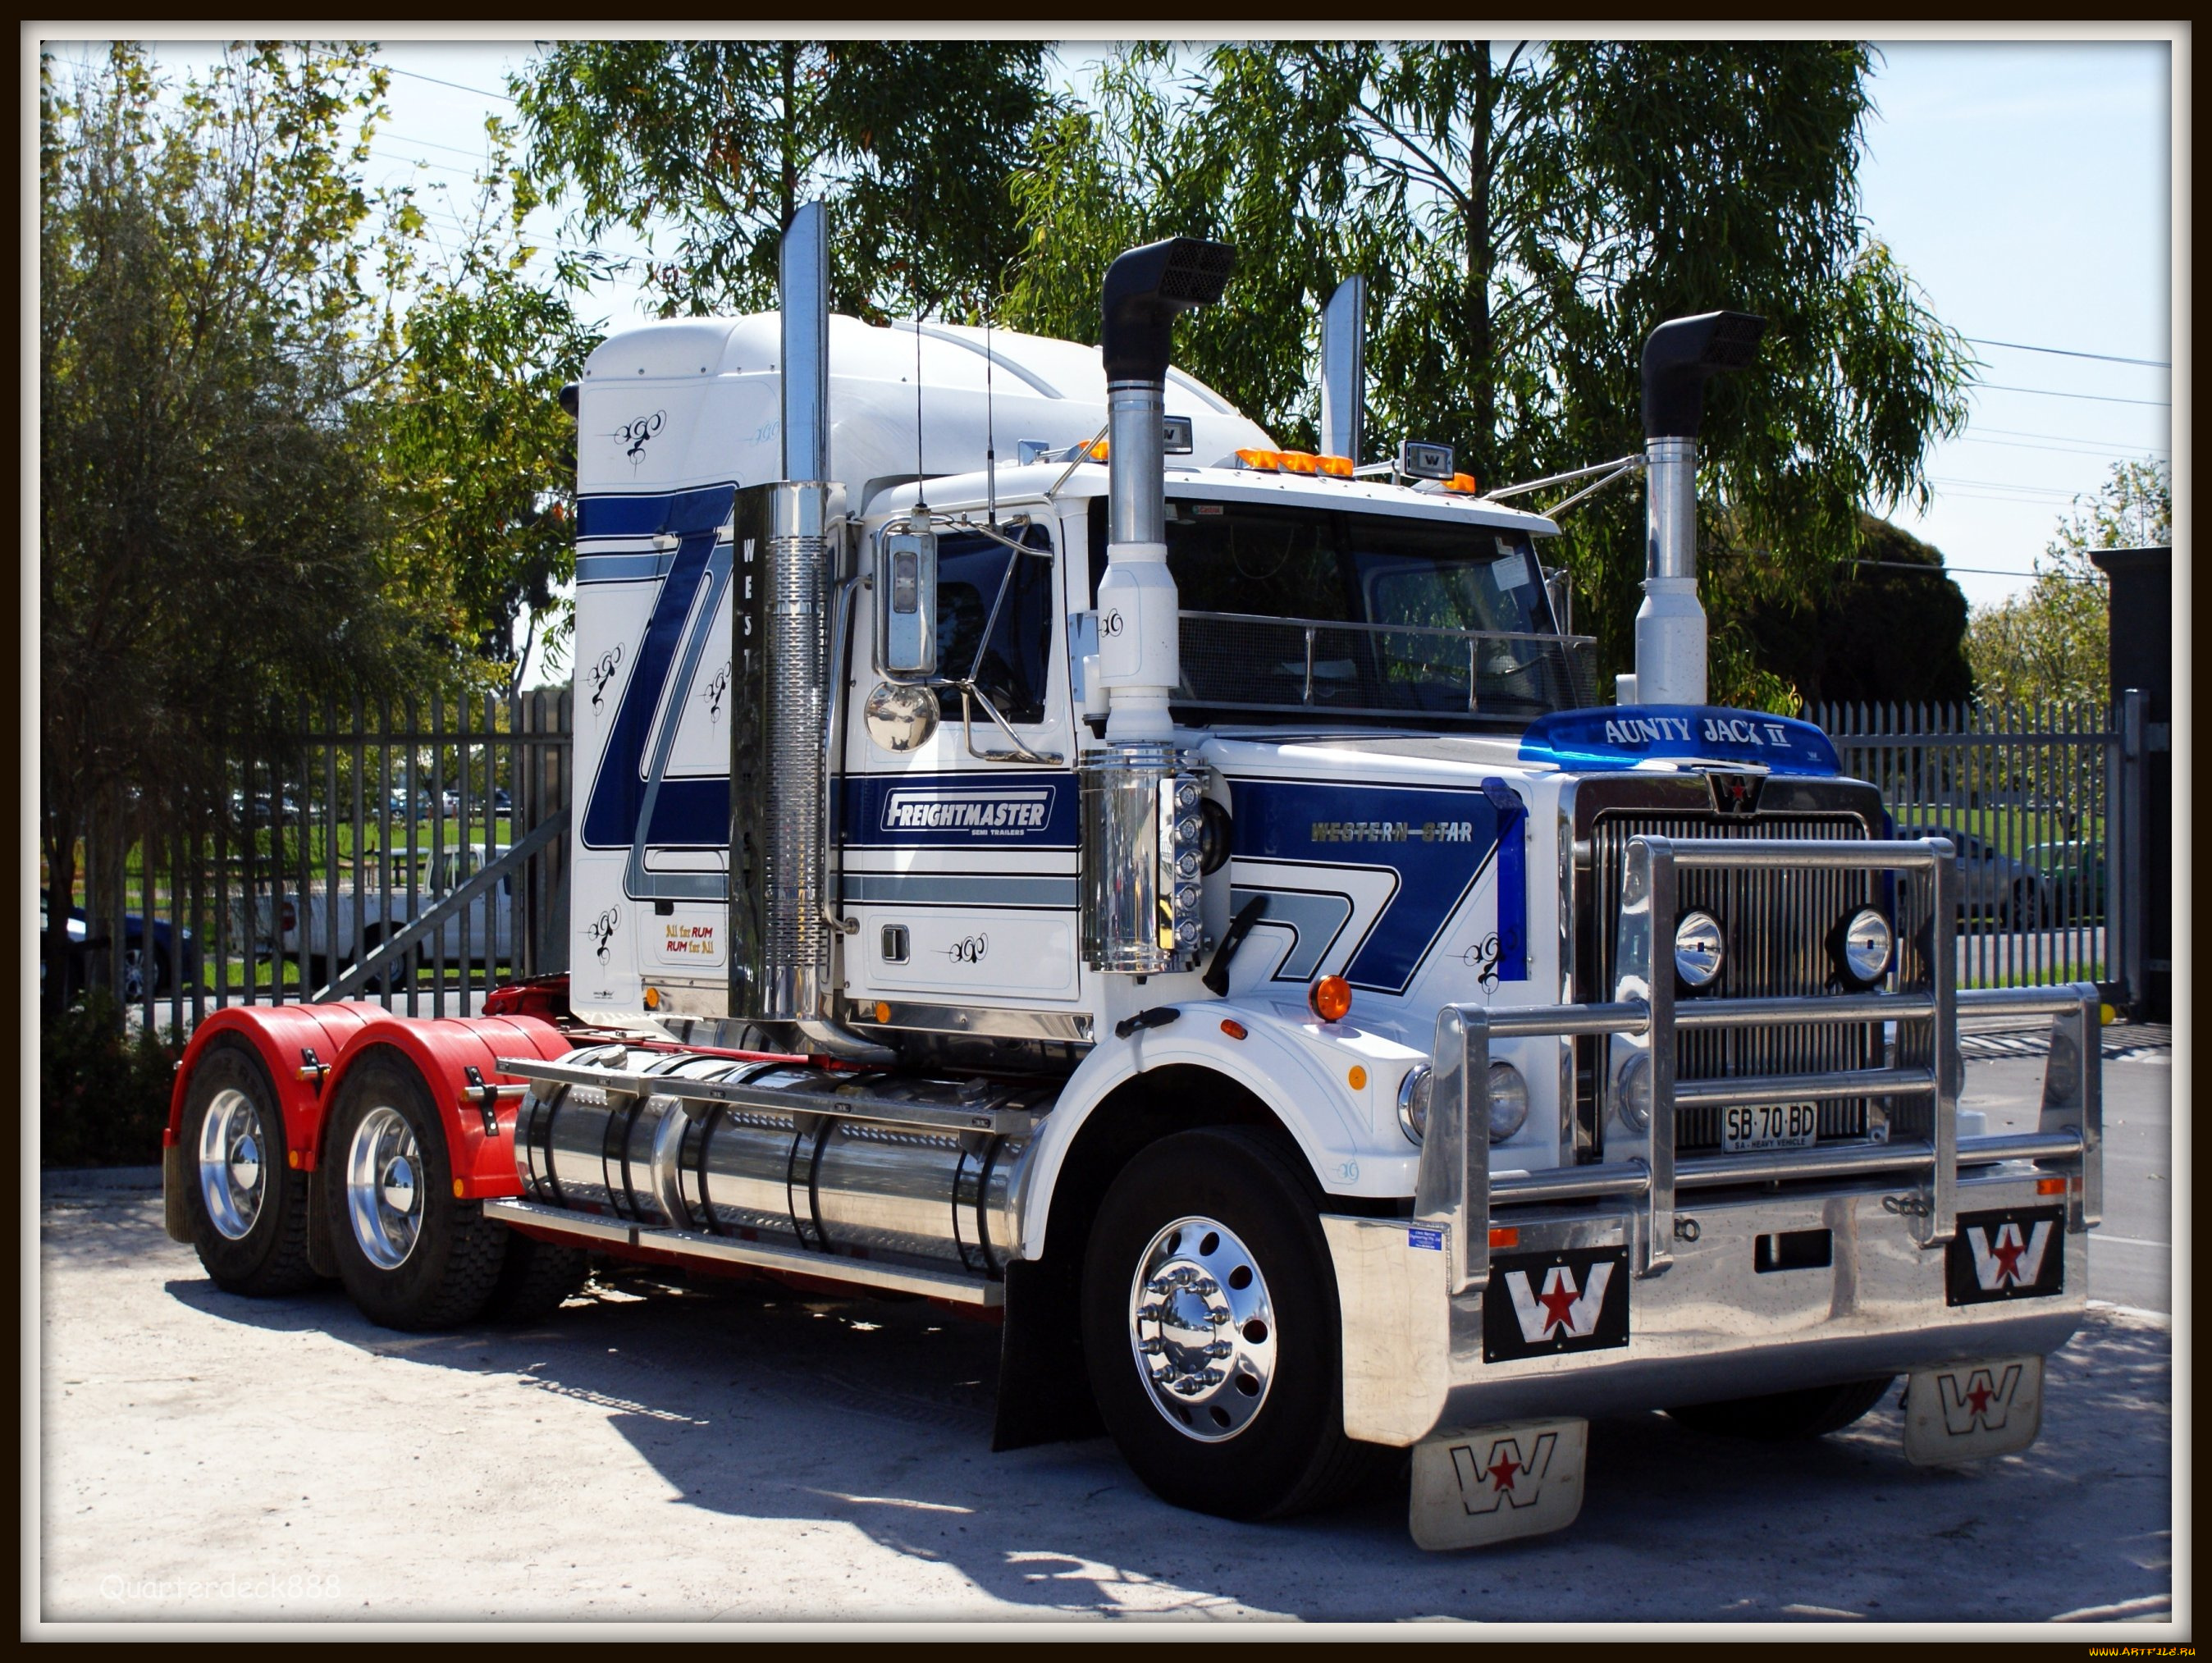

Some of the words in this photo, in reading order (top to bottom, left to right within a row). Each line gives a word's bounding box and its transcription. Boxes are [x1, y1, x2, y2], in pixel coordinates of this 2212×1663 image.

[1606, 718, 1691, 743] AUNTY
[1704, 719, 1763, 745] JACK
[1764, 724, 1791, 747] II
[887, 792, 1048, 827] FREIGHTMASTER
[1311, 822, 1408, 842] WESTERN
[1422, 822, 1472, 842] STAR
[666, 925, 678, 938] All
[679, 925, 690, 938] for
[692, 927, 713, 938] RUM
[666, 940, 688, 952] RUM
[688, 940, 700, 953] for
[702, 940, 714, 954] All
[1752, 1140, 1773, 1148] HEAVY
[1777, 1138, 1806, 1146] VEHICLE
